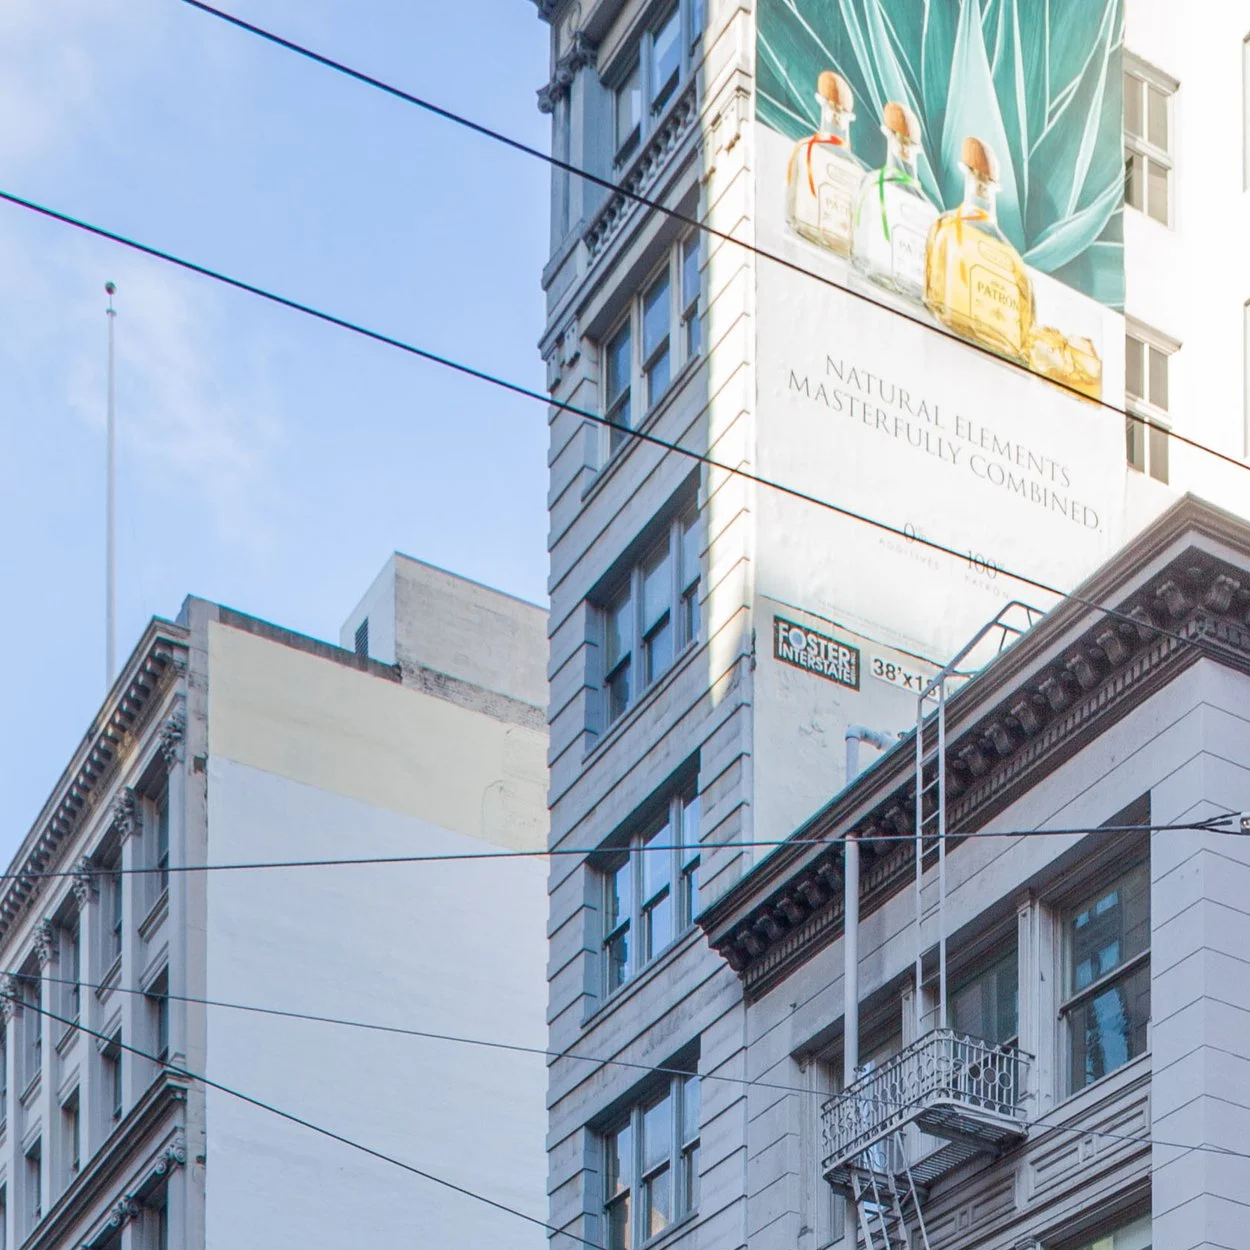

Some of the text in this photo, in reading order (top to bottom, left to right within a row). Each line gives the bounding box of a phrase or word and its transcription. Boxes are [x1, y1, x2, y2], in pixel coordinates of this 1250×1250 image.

[787, 369, 1104, 534] MASTERFULLY COMBINED.
[825, 354, 1071, 488] NATURAL ELEMENTS
[778, 622, 851, 668] FOSTER
[778, 642, 853, 683] INTERSTATE
